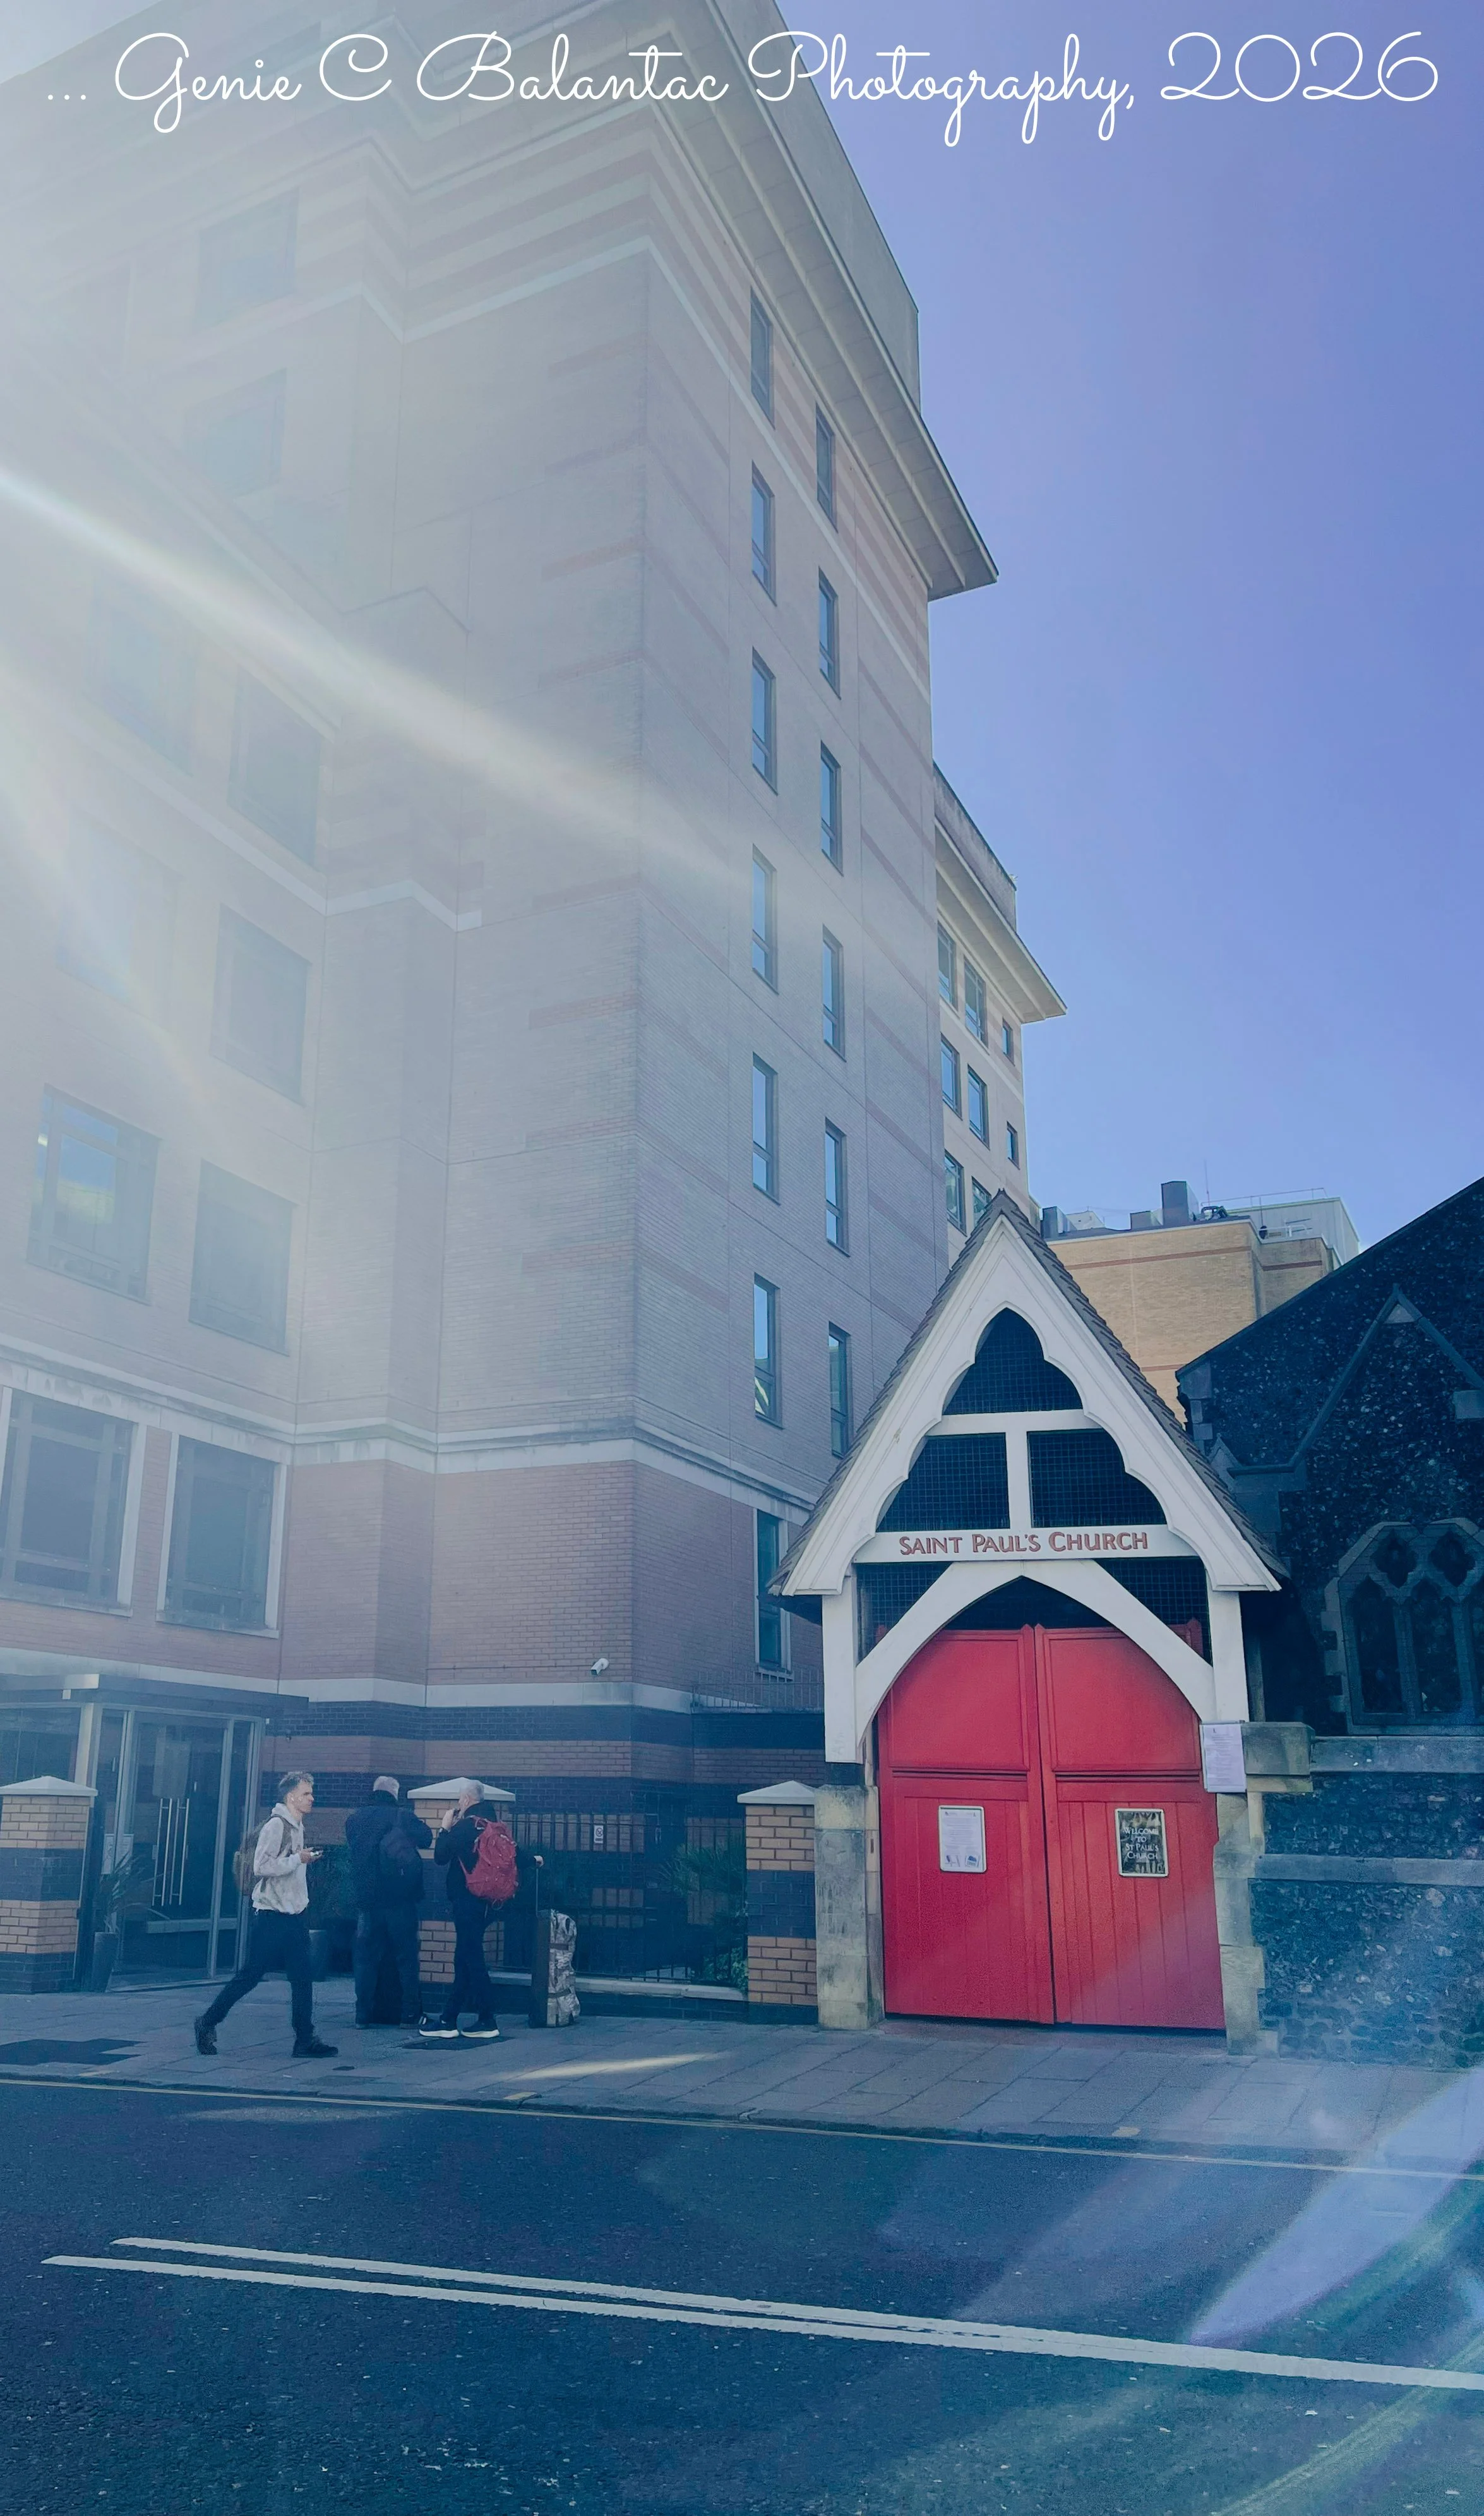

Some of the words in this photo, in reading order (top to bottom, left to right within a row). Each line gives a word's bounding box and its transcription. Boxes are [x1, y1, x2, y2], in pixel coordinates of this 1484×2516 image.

[899, 1536, 963, 1555] SAINT
[972, 1534, 1041, 1553] PAUL'S
[1048, 1531, 1148, 1552] CHURCH
[1123, 1827, 1159, 1835] WELCOME
[1135, 1843, 1159, 1851] PAUL'S
[1127, 1851, 1158, 1860] CHURCH
